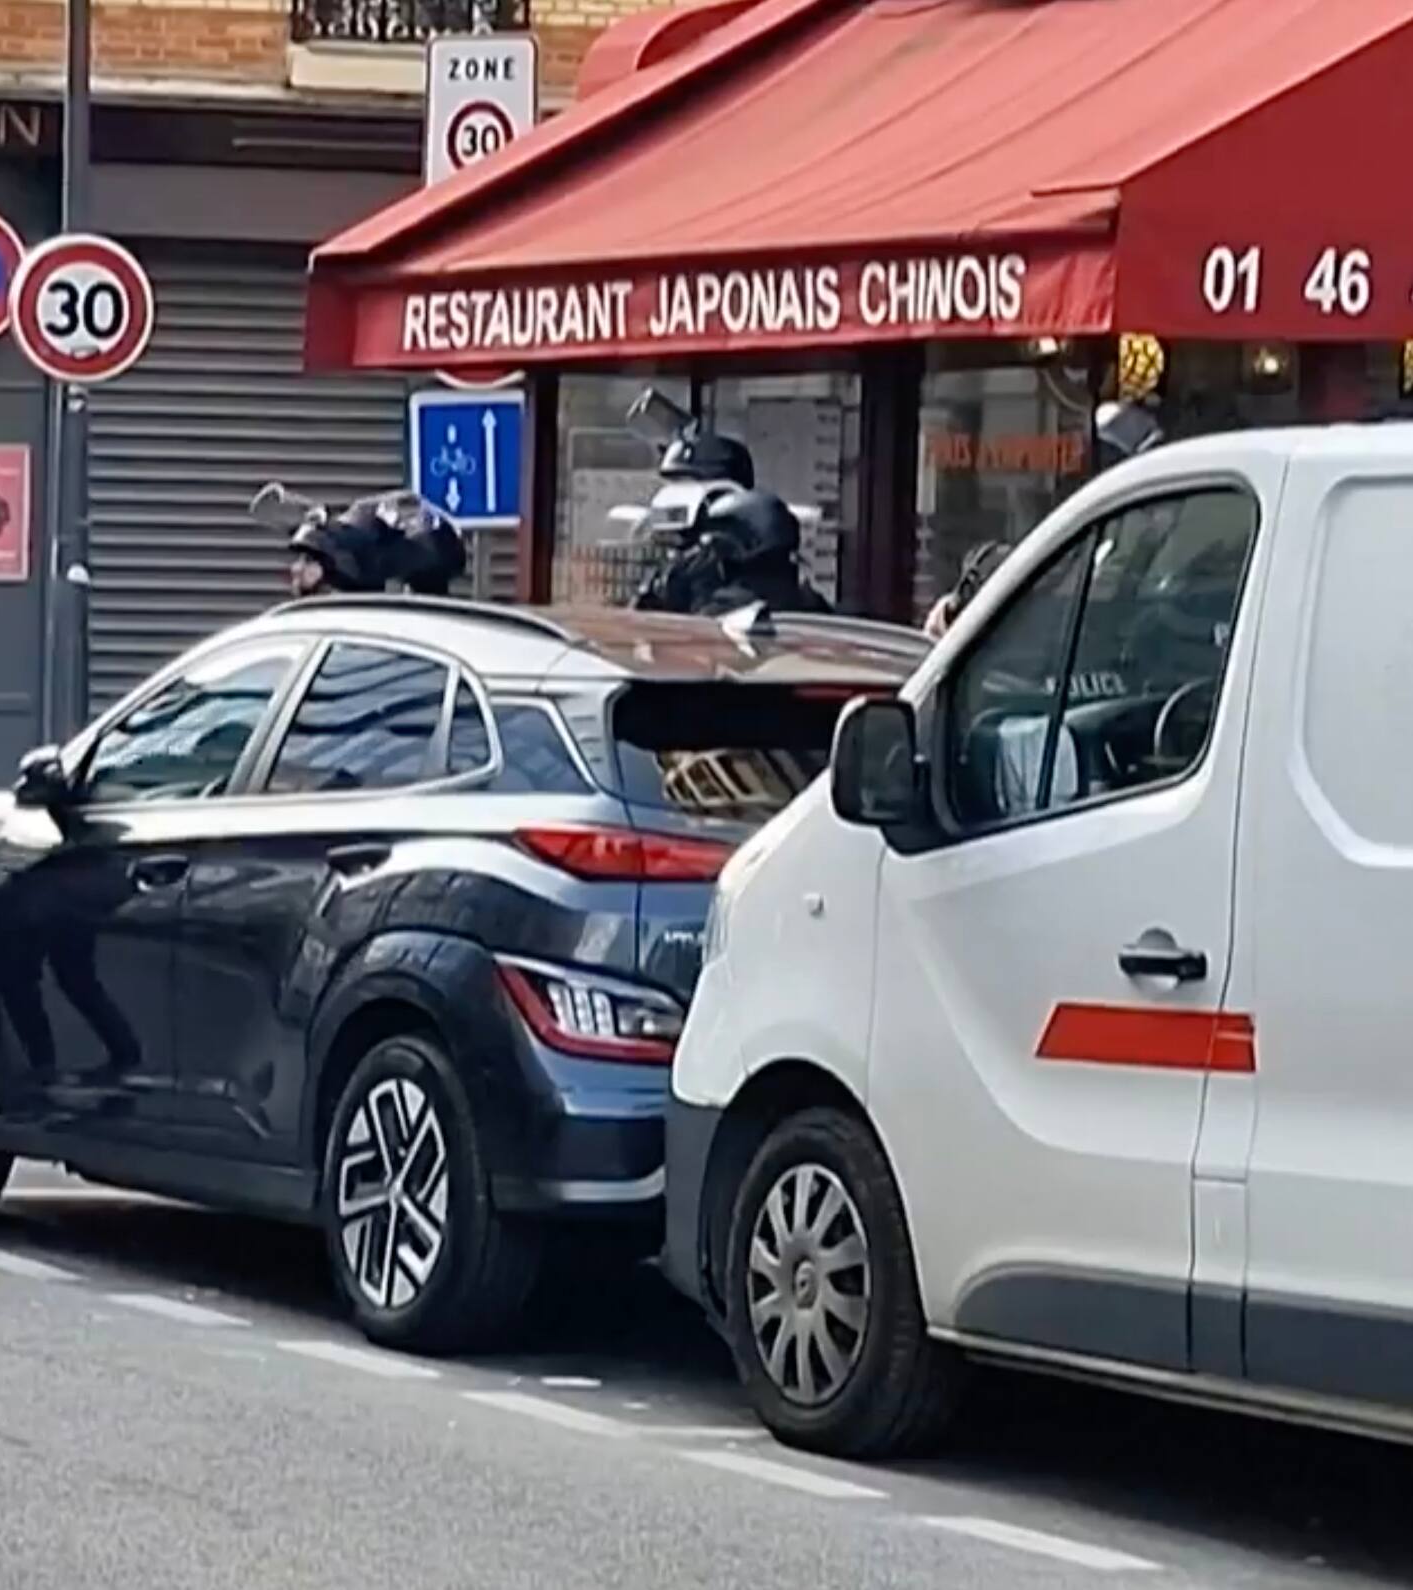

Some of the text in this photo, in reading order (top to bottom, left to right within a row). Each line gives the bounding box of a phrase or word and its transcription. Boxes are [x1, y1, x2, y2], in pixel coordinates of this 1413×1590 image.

[448, 57, 516, 81] ZONE
[462, 124, 501, 158] 30
[45, 280, 125, 338] 30
[403, 253, 1027, 351] RESTAURANT JAPONAIS CHINOIS
[1203, 245, 1371, 316] 01 46
